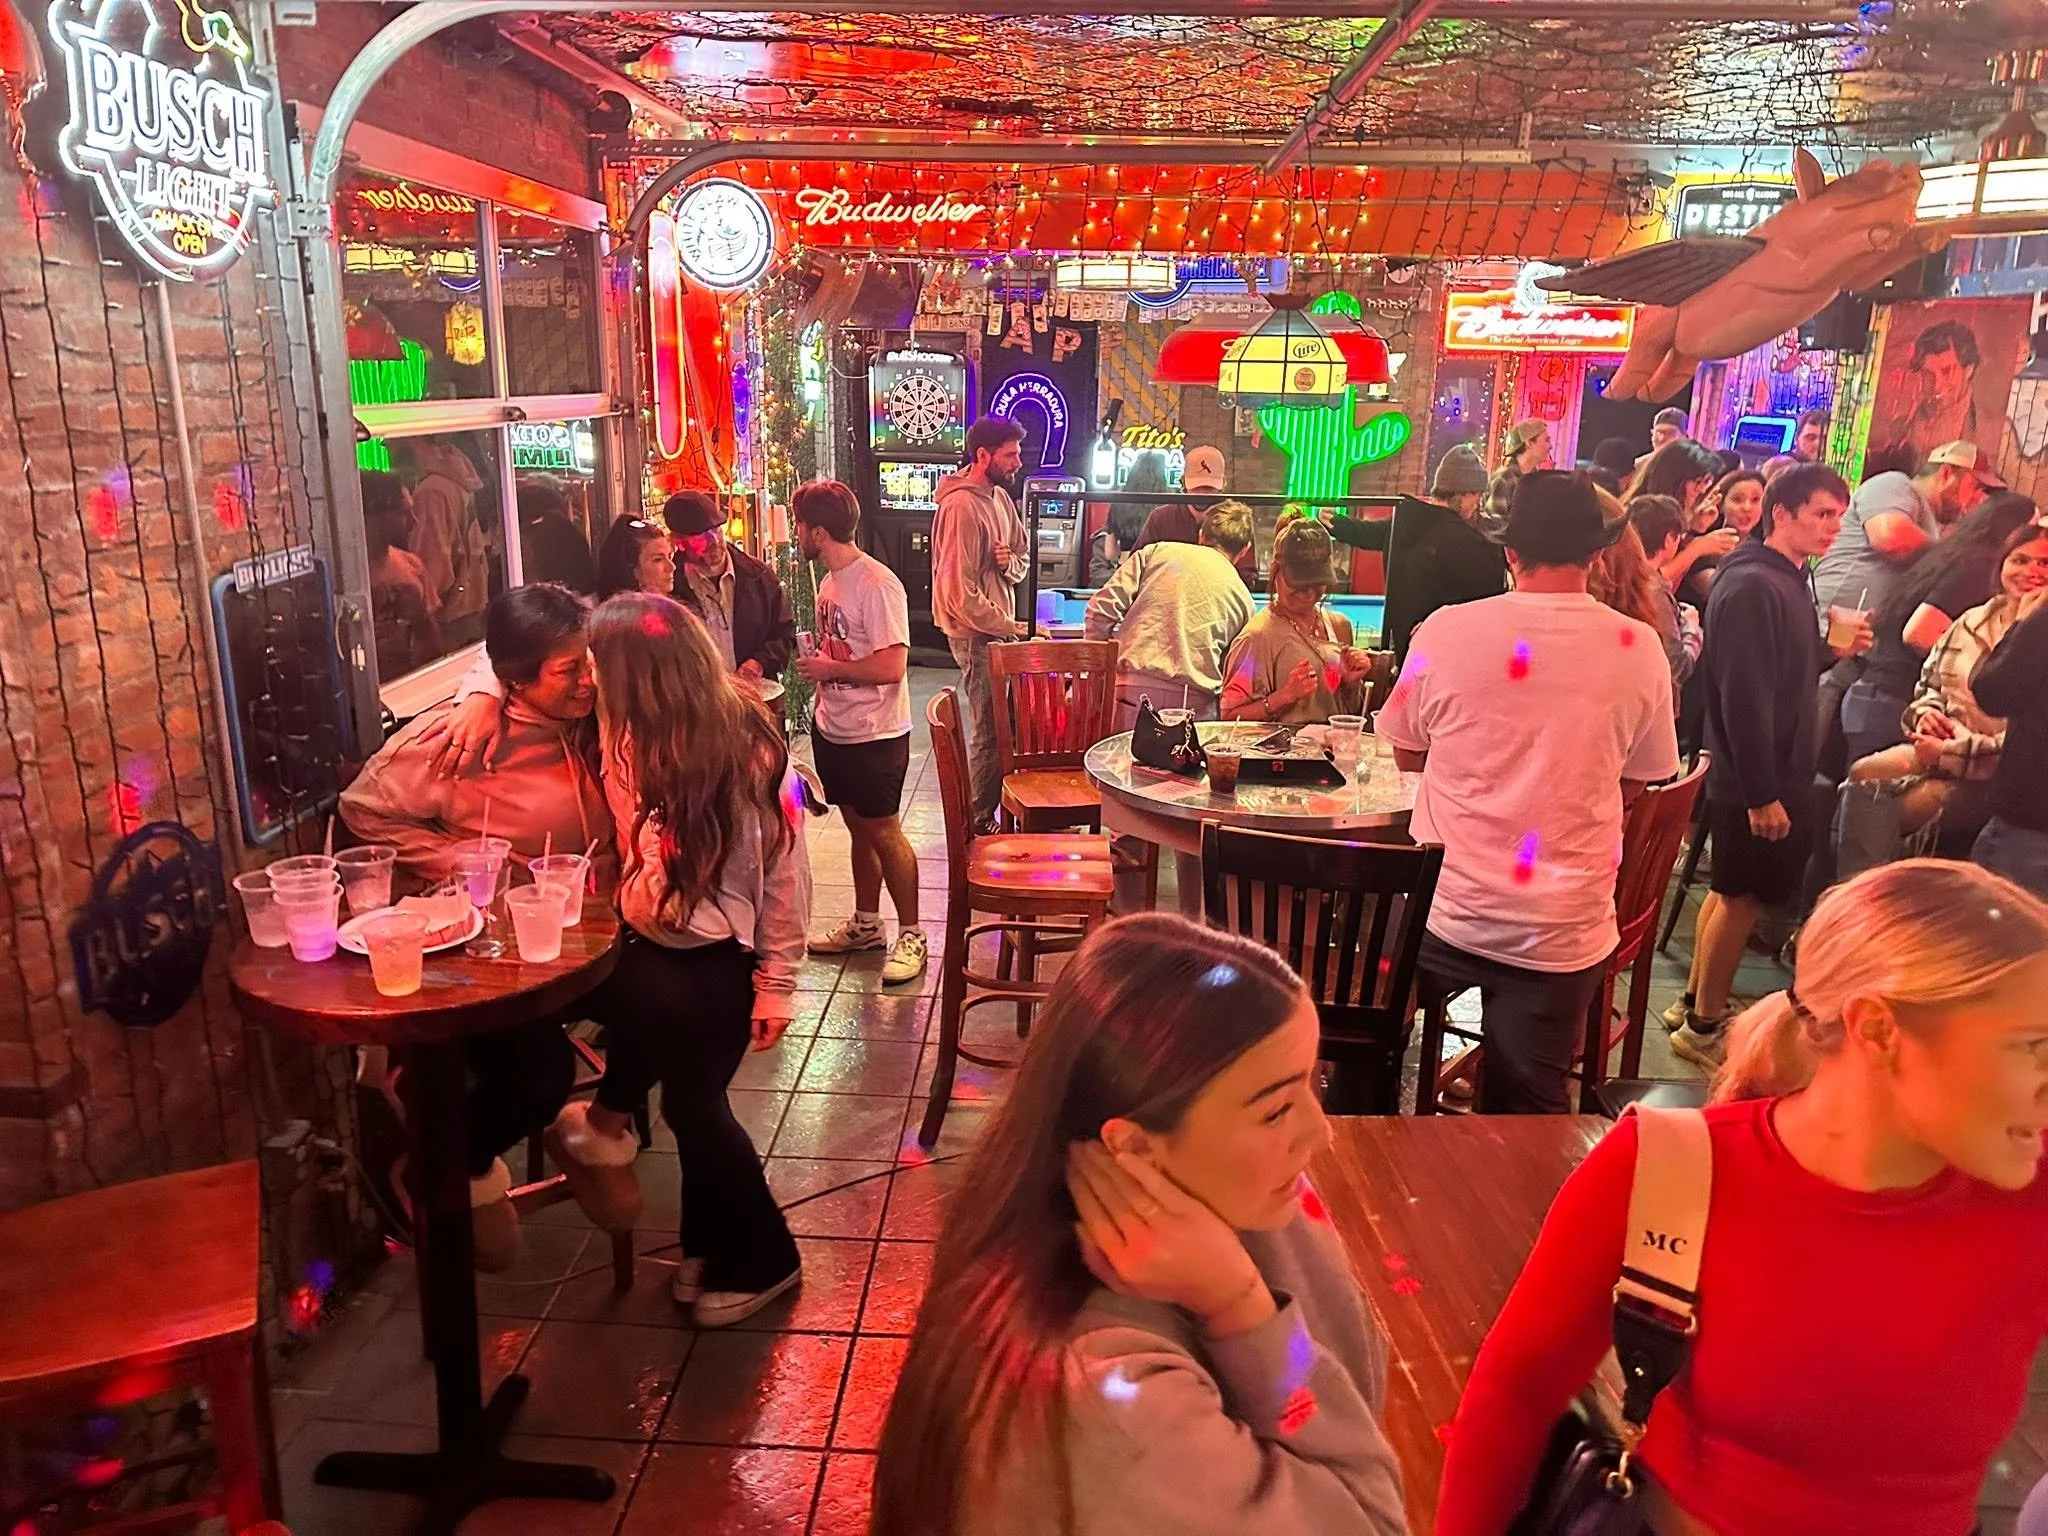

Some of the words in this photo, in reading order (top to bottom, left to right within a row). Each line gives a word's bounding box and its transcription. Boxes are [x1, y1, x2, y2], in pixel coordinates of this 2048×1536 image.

[79, 36, 267, 186] BUSCH
[134, 155, 237, 222] LIGHT
[796, 188, 986, 226] Budweiser
[172, 231, 208, 256] OPEN
[1451, 305, 1629, 340] Budweiser
[1121, 423, 1186, 449] Tito's
[1117, 447, 1186, 468] SA
[1058, 482, 1080, 493] ATM
[1117, 466, 1184, 489] LE
[1642, 1229, 1688, 1255] MC
